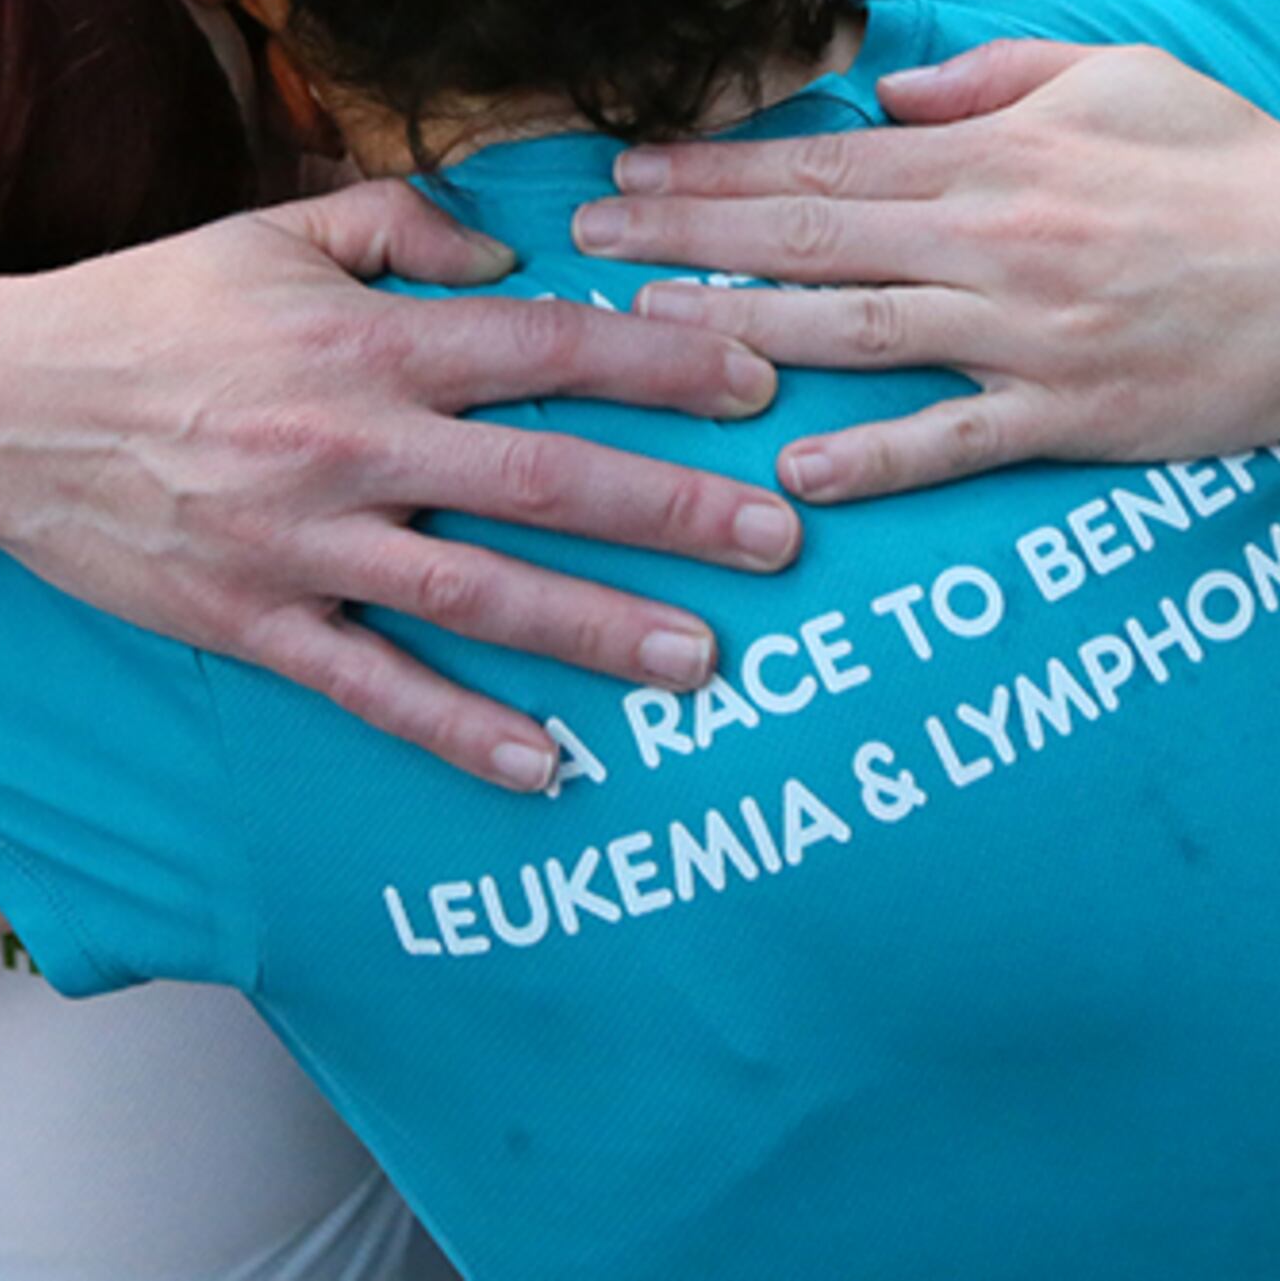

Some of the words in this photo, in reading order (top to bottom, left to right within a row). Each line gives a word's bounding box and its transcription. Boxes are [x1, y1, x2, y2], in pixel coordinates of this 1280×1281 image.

[622, 609, 872, 769] RACE
[870, 565, 1004, 661] TO
[384, 778, 852, 956] LEUKEMIA
[853, 741, 927, 822] &
